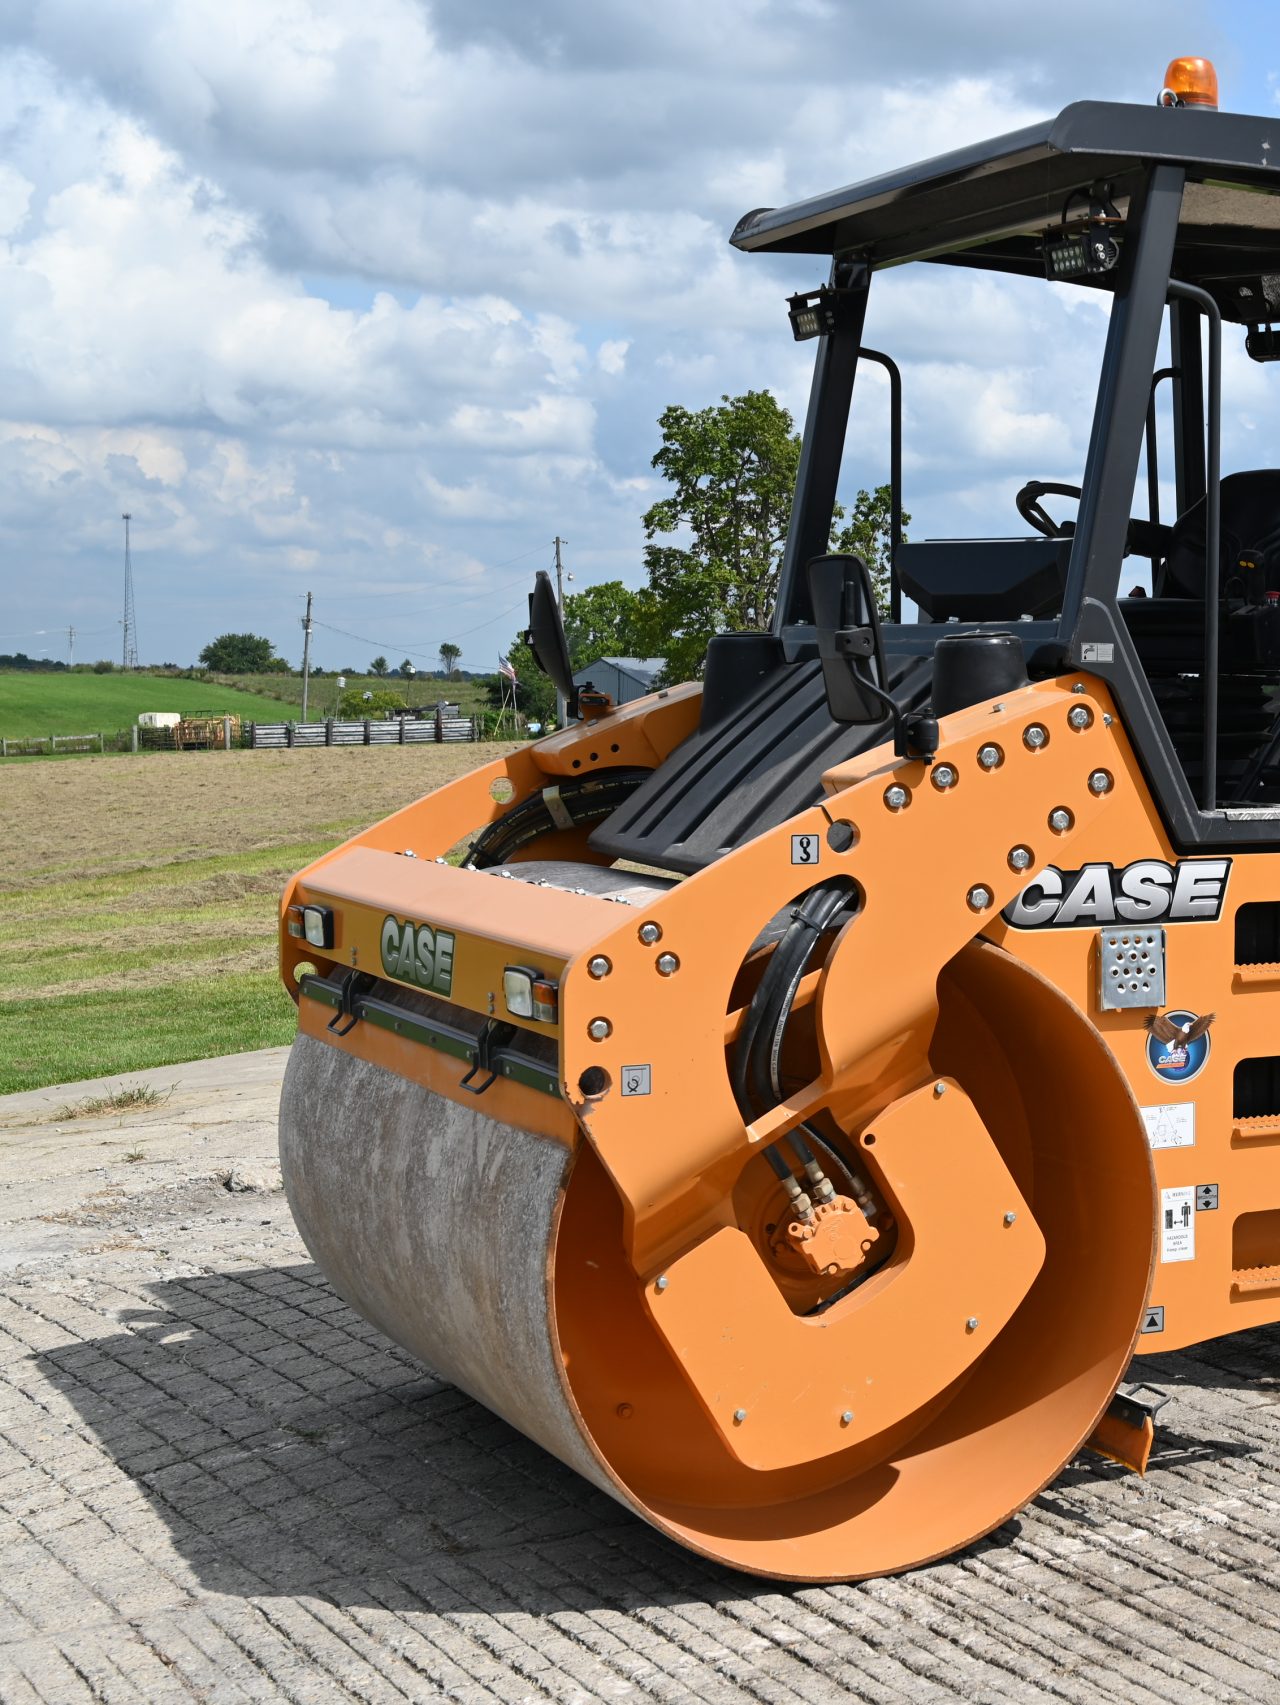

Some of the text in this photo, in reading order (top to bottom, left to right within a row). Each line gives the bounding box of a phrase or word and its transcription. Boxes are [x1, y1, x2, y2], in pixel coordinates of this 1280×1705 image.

[1008, 860, 1230, 927] CASE
[381, 914, 455, 993] CASE
[1158, 1054, 1187, 1064] CASE
